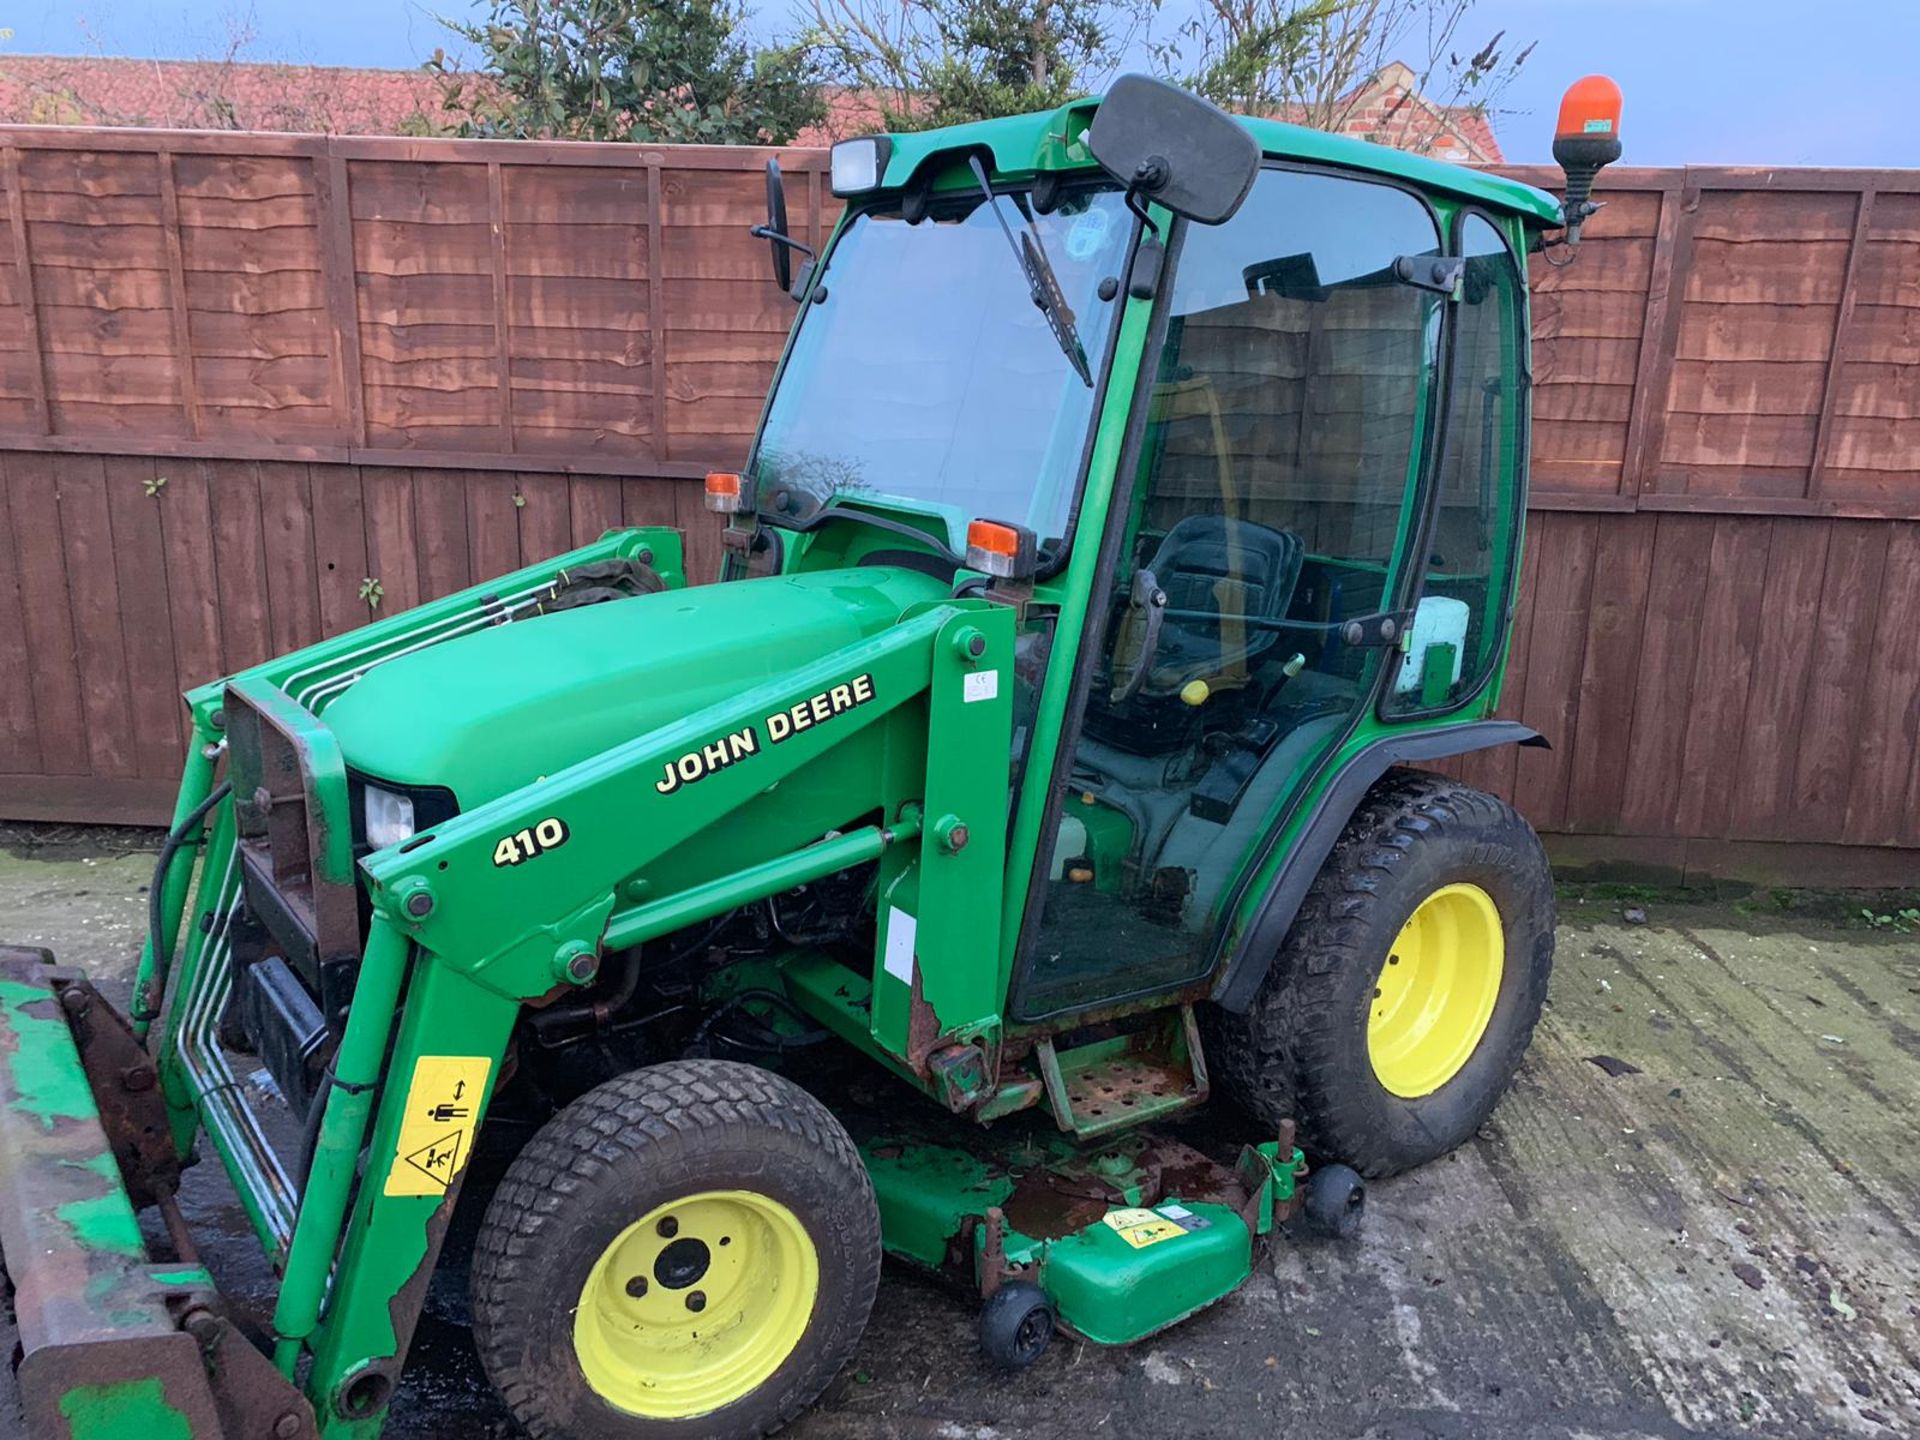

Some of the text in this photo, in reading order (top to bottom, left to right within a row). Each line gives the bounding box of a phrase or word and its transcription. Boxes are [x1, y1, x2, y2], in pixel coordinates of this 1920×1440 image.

[655, 673, 874, 794] JOHN DEERE
[493, 817, 566, 866] 410
